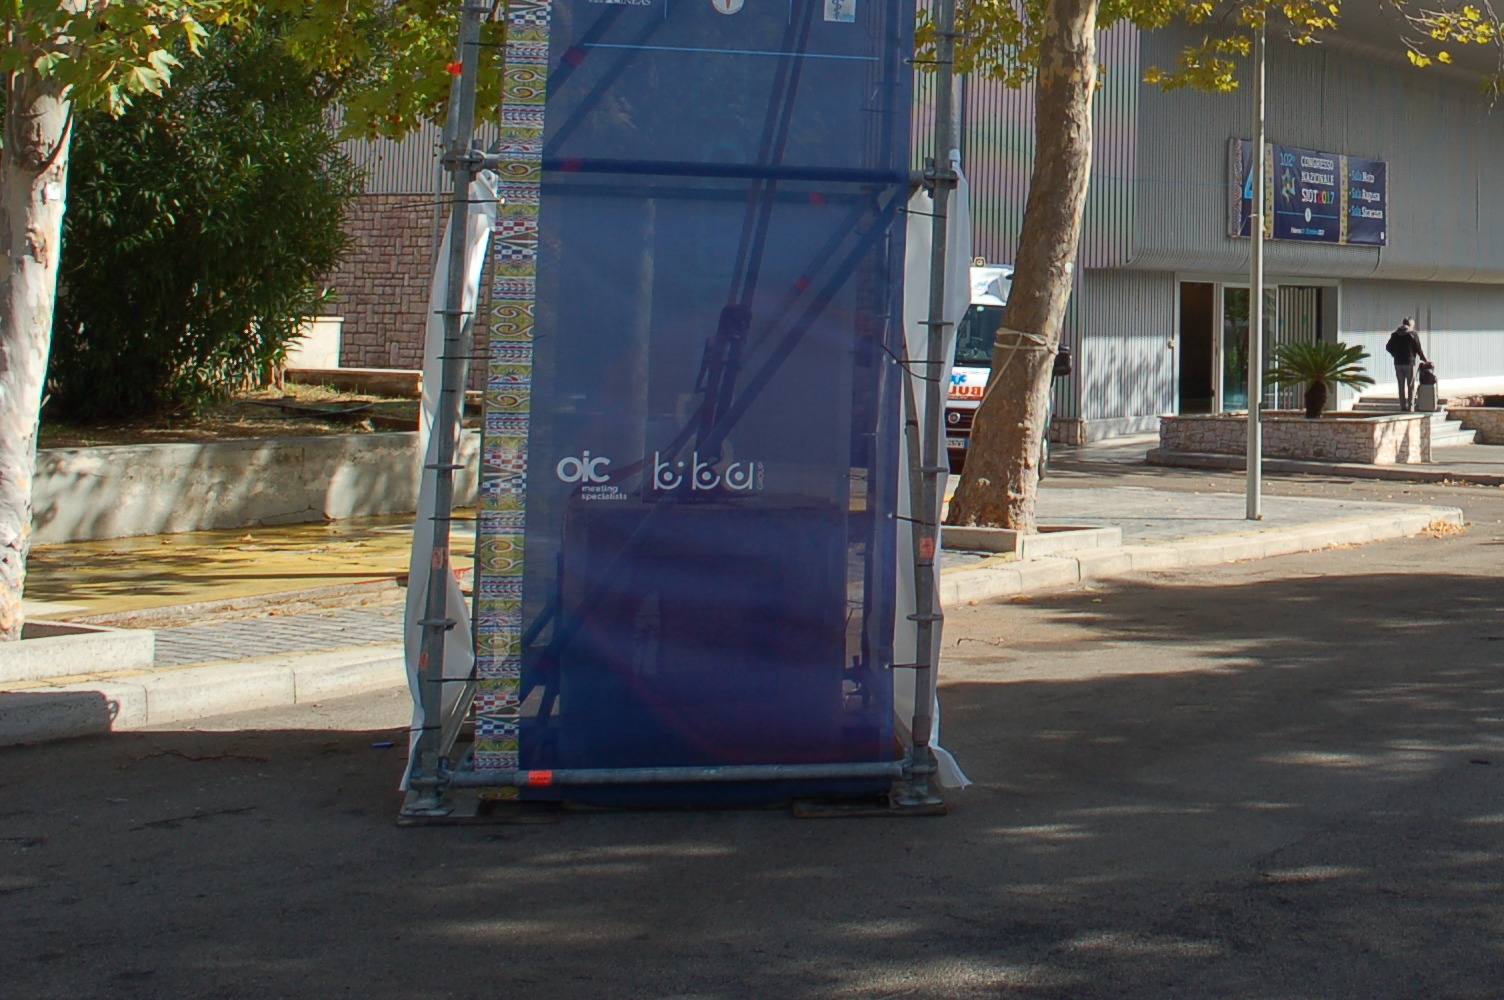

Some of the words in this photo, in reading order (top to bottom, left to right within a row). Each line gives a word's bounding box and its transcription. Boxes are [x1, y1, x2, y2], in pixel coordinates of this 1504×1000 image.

[1301, 156, 1335, 171] CONGRESSO
[1301, 171, 1335, 186] NAZIONALE
[581, 485, 619, 494] meeting
[581, 493, 628, 502] specialists
